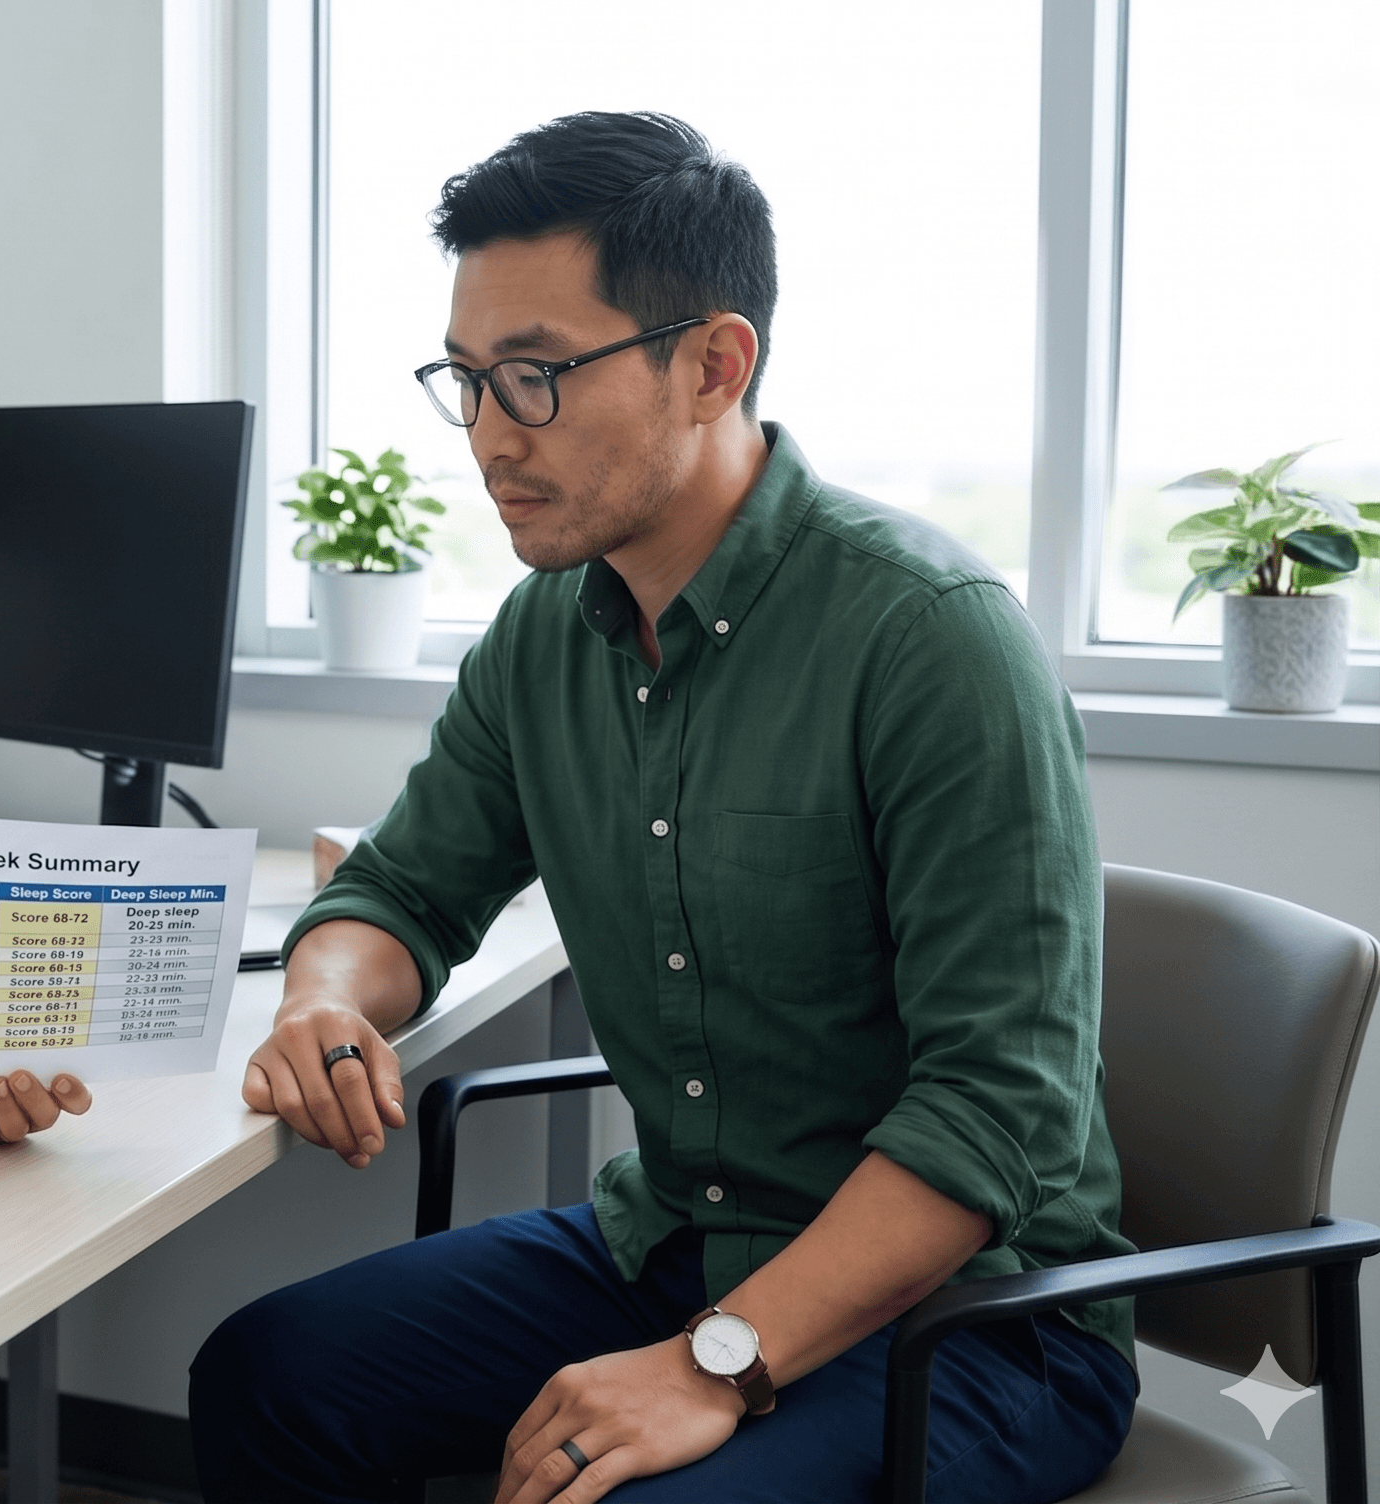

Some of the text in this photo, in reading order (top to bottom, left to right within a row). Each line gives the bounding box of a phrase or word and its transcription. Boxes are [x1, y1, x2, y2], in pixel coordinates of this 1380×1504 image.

[28, 852, 140, 876] Summary
[10, 886, 92, 900] Sleep Score
[111, 889, 218, 901] Deep Sleep Min.
[165, 907, 199, 917] sleep
[11, 912, 88, 923] Score 68-72
[129, 920, 195, 930] 20-25 min.
[12, 937, 47, 945] Score
[166, 935, 192, 943] min.
[12, 951, 46, 959] Score
[165, 947, 190, 956] min.
[11, 964, 45, 972] Score
[163, 960, 188, 969] min.
[162, 972, 186, 981] min.
[10, 978, 44, 986] Score
[9, 991, 42, 999] Score
[7, 1016, 40, 1024] Score
[5, 1028, 38, 1036] Score
[4, 1040, 37, 1048] Score
